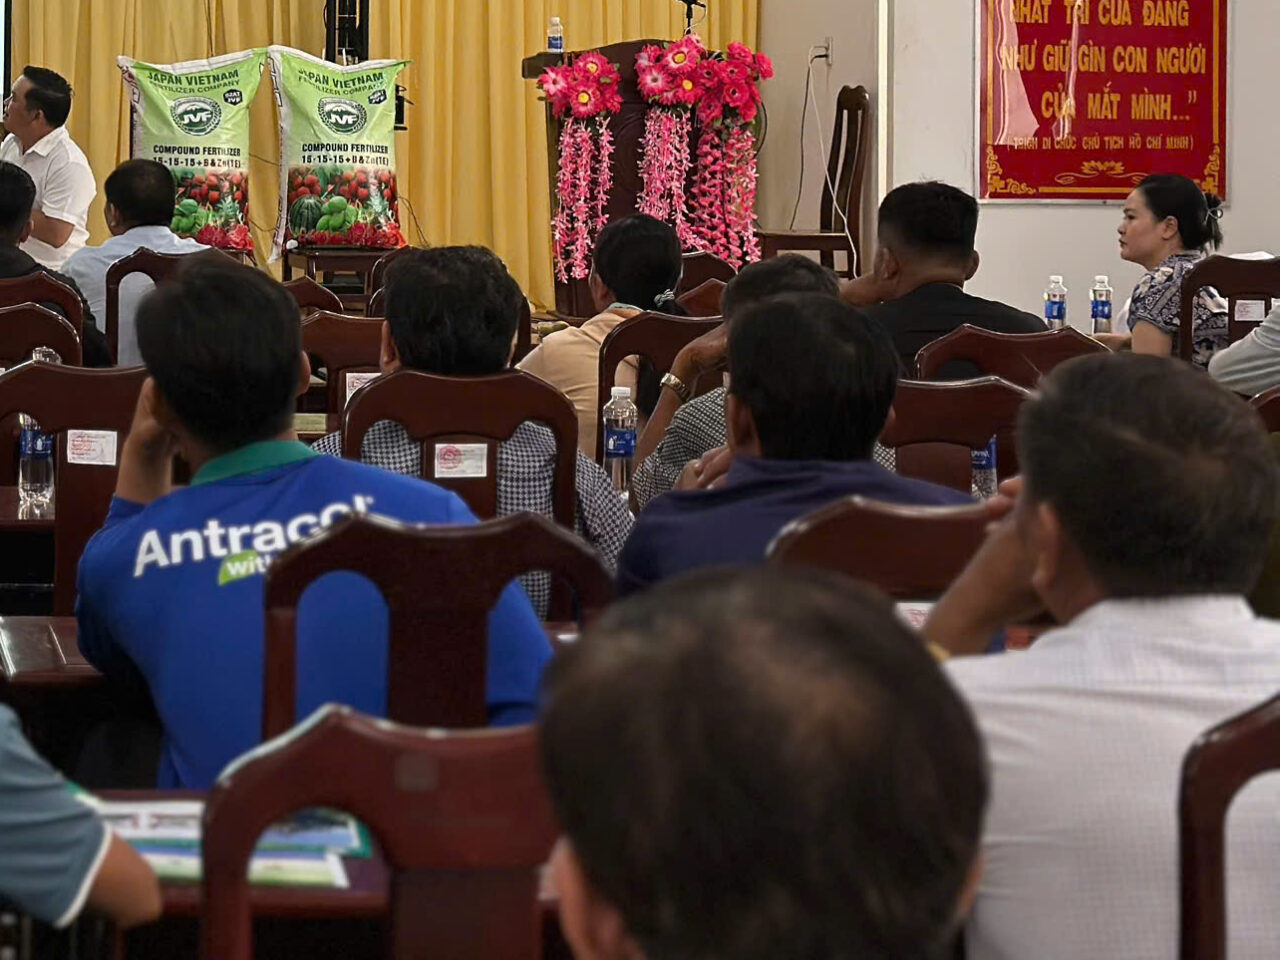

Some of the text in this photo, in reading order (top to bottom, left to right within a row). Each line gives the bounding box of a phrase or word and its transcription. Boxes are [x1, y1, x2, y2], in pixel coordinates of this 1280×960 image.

[1001, 38, 1037, 72] NHƯ
[1078, 39, 1105, 73] GÌN
[1113, 46, 1147, 73] CON
[148, 69, 239, 86] JAPAN VIETNAM
[332, 72, 384, 89] VIETNAM
[197, 79, 240, 93] COMPANY
[1041, 83, 1076, 119] CỦA
[1087, 81, 1120, 120] MẮT
[182, 111, 212, 124] JVF
[329, 114, 358, 124] JVF
[153, 145, 200, 155] COMPOUND
[302, 143, 388, 154] COMPOUND FERTILIZER
